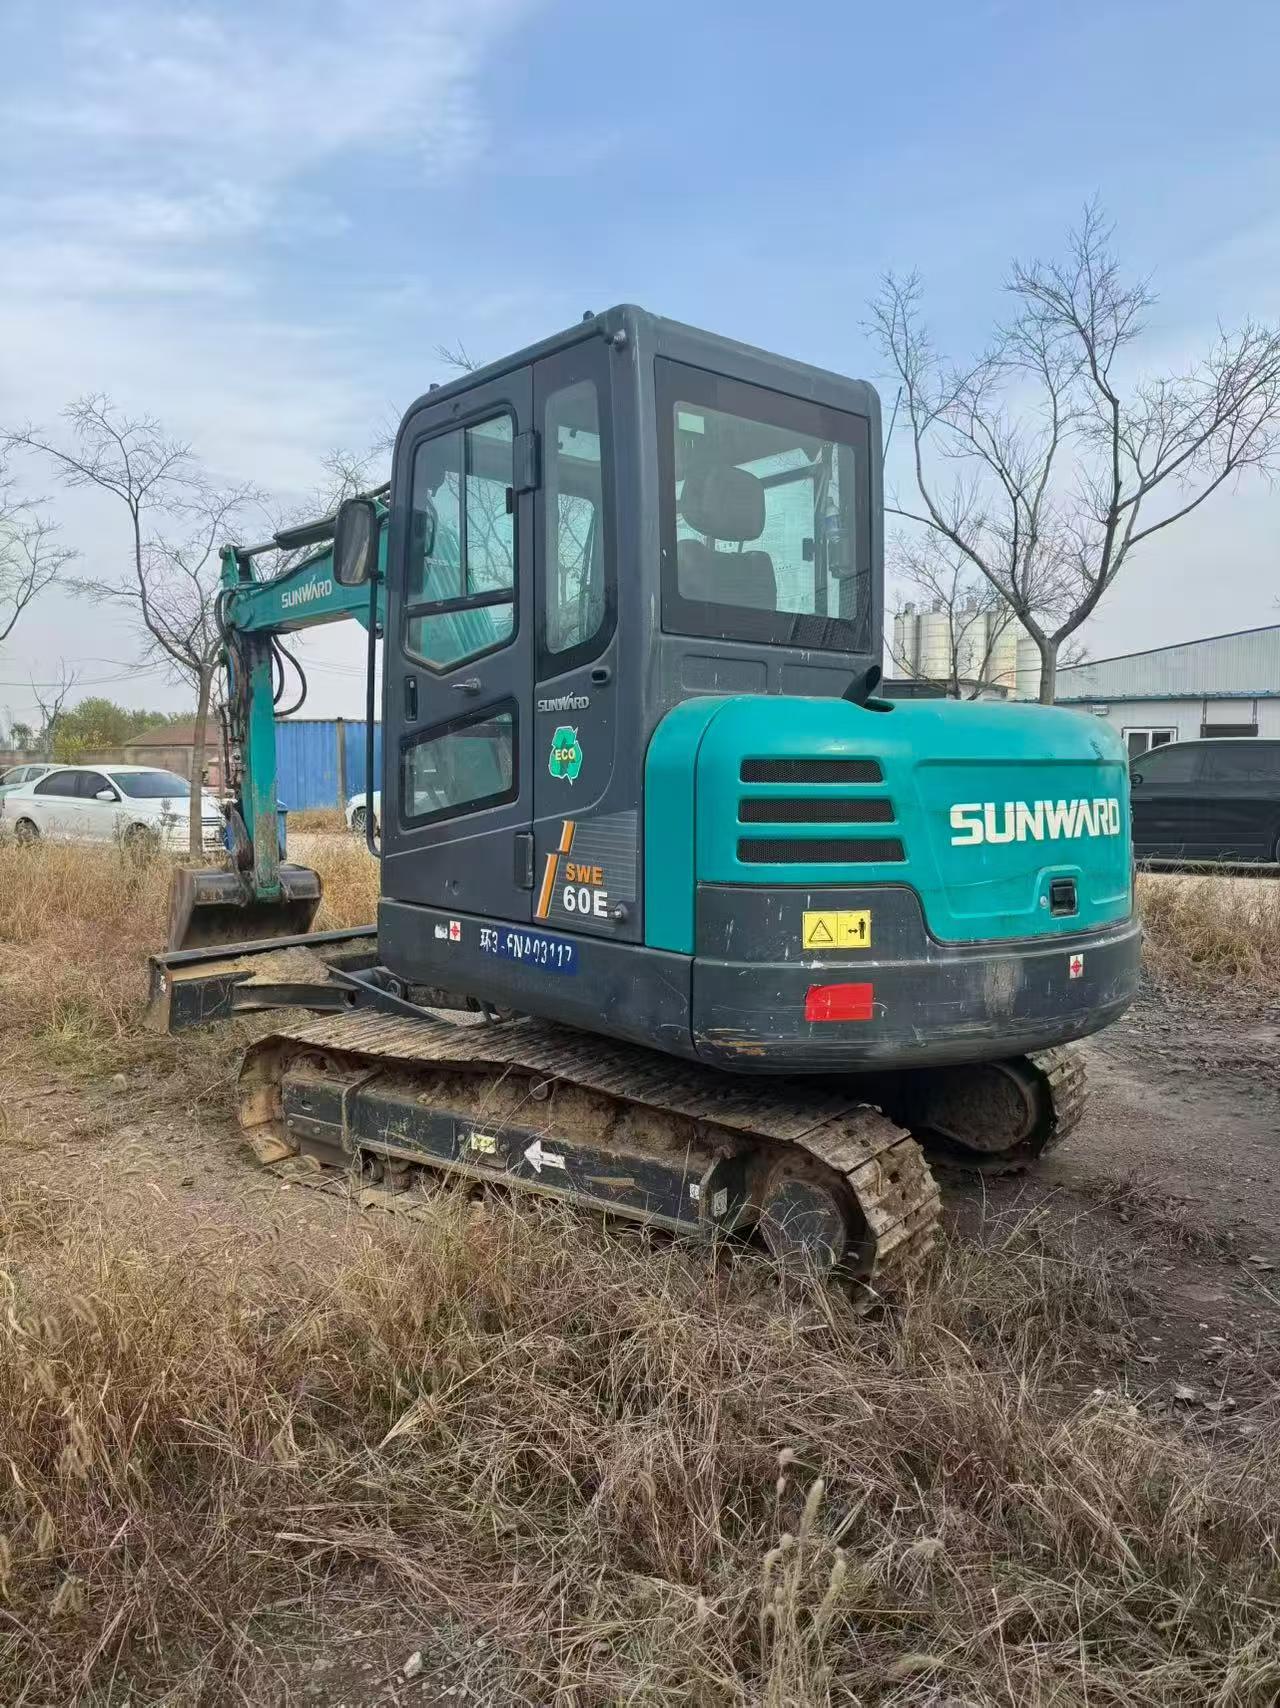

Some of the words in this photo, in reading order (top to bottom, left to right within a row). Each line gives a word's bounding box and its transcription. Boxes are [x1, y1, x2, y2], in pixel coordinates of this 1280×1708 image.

[281, 575, 332, 608] SUNWARD
[536, 692, 590, 712] SUNWARD
[555, 748, 576, 762] ECO
[949, 798, 1120, 846] SUNWARD
[565, 863, 603, 885] SWE
[562, 886, 607, 918] 60E
